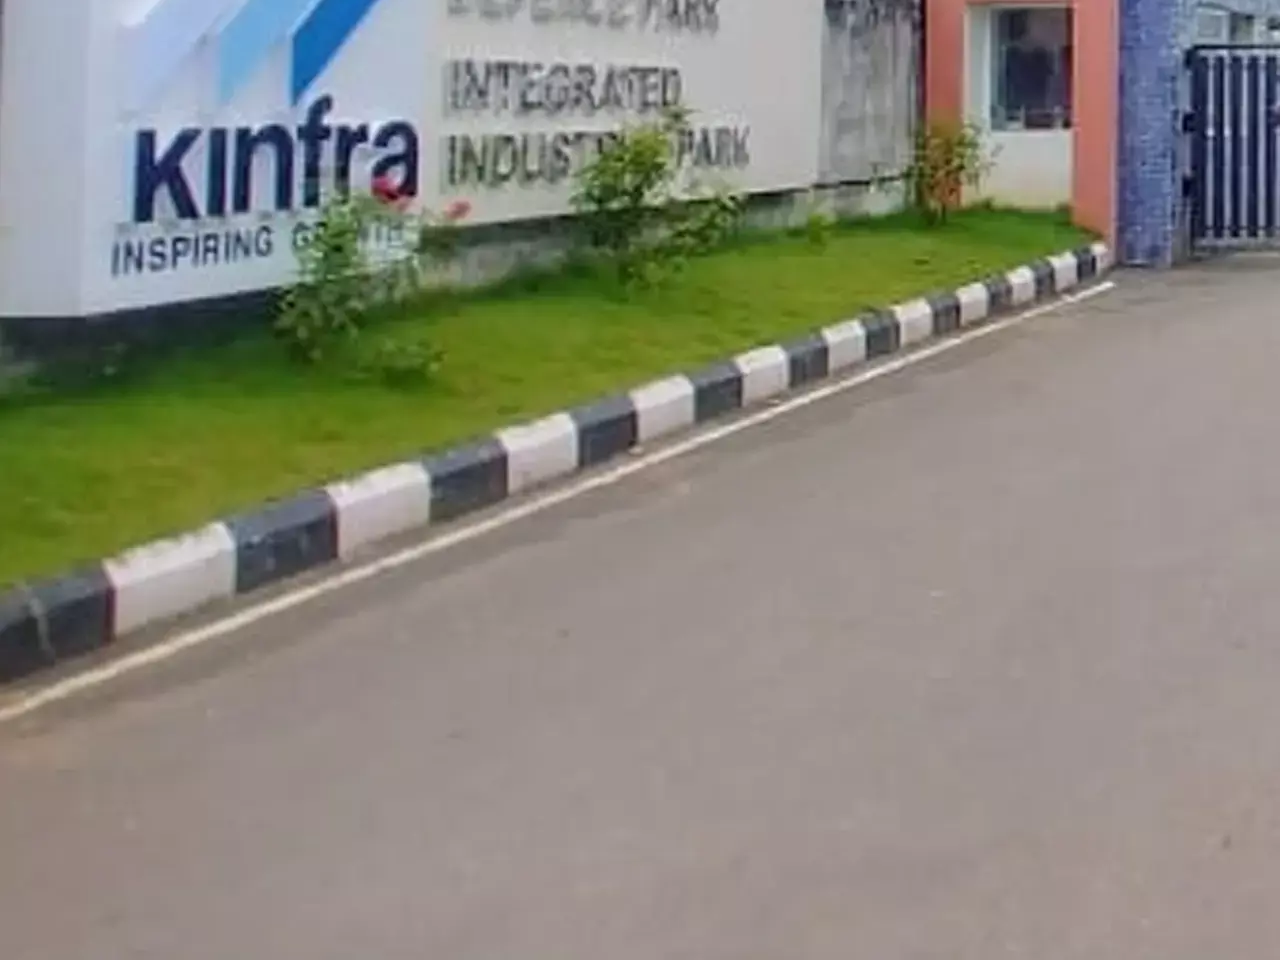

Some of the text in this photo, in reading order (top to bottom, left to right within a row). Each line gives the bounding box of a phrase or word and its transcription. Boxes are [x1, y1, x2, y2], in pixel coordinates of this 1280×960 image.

[445, 58, 683, 117] INTEGRATED
[444, 131, 634, 188] INDUST
[111, 225, 274, 277] INSPIRING
